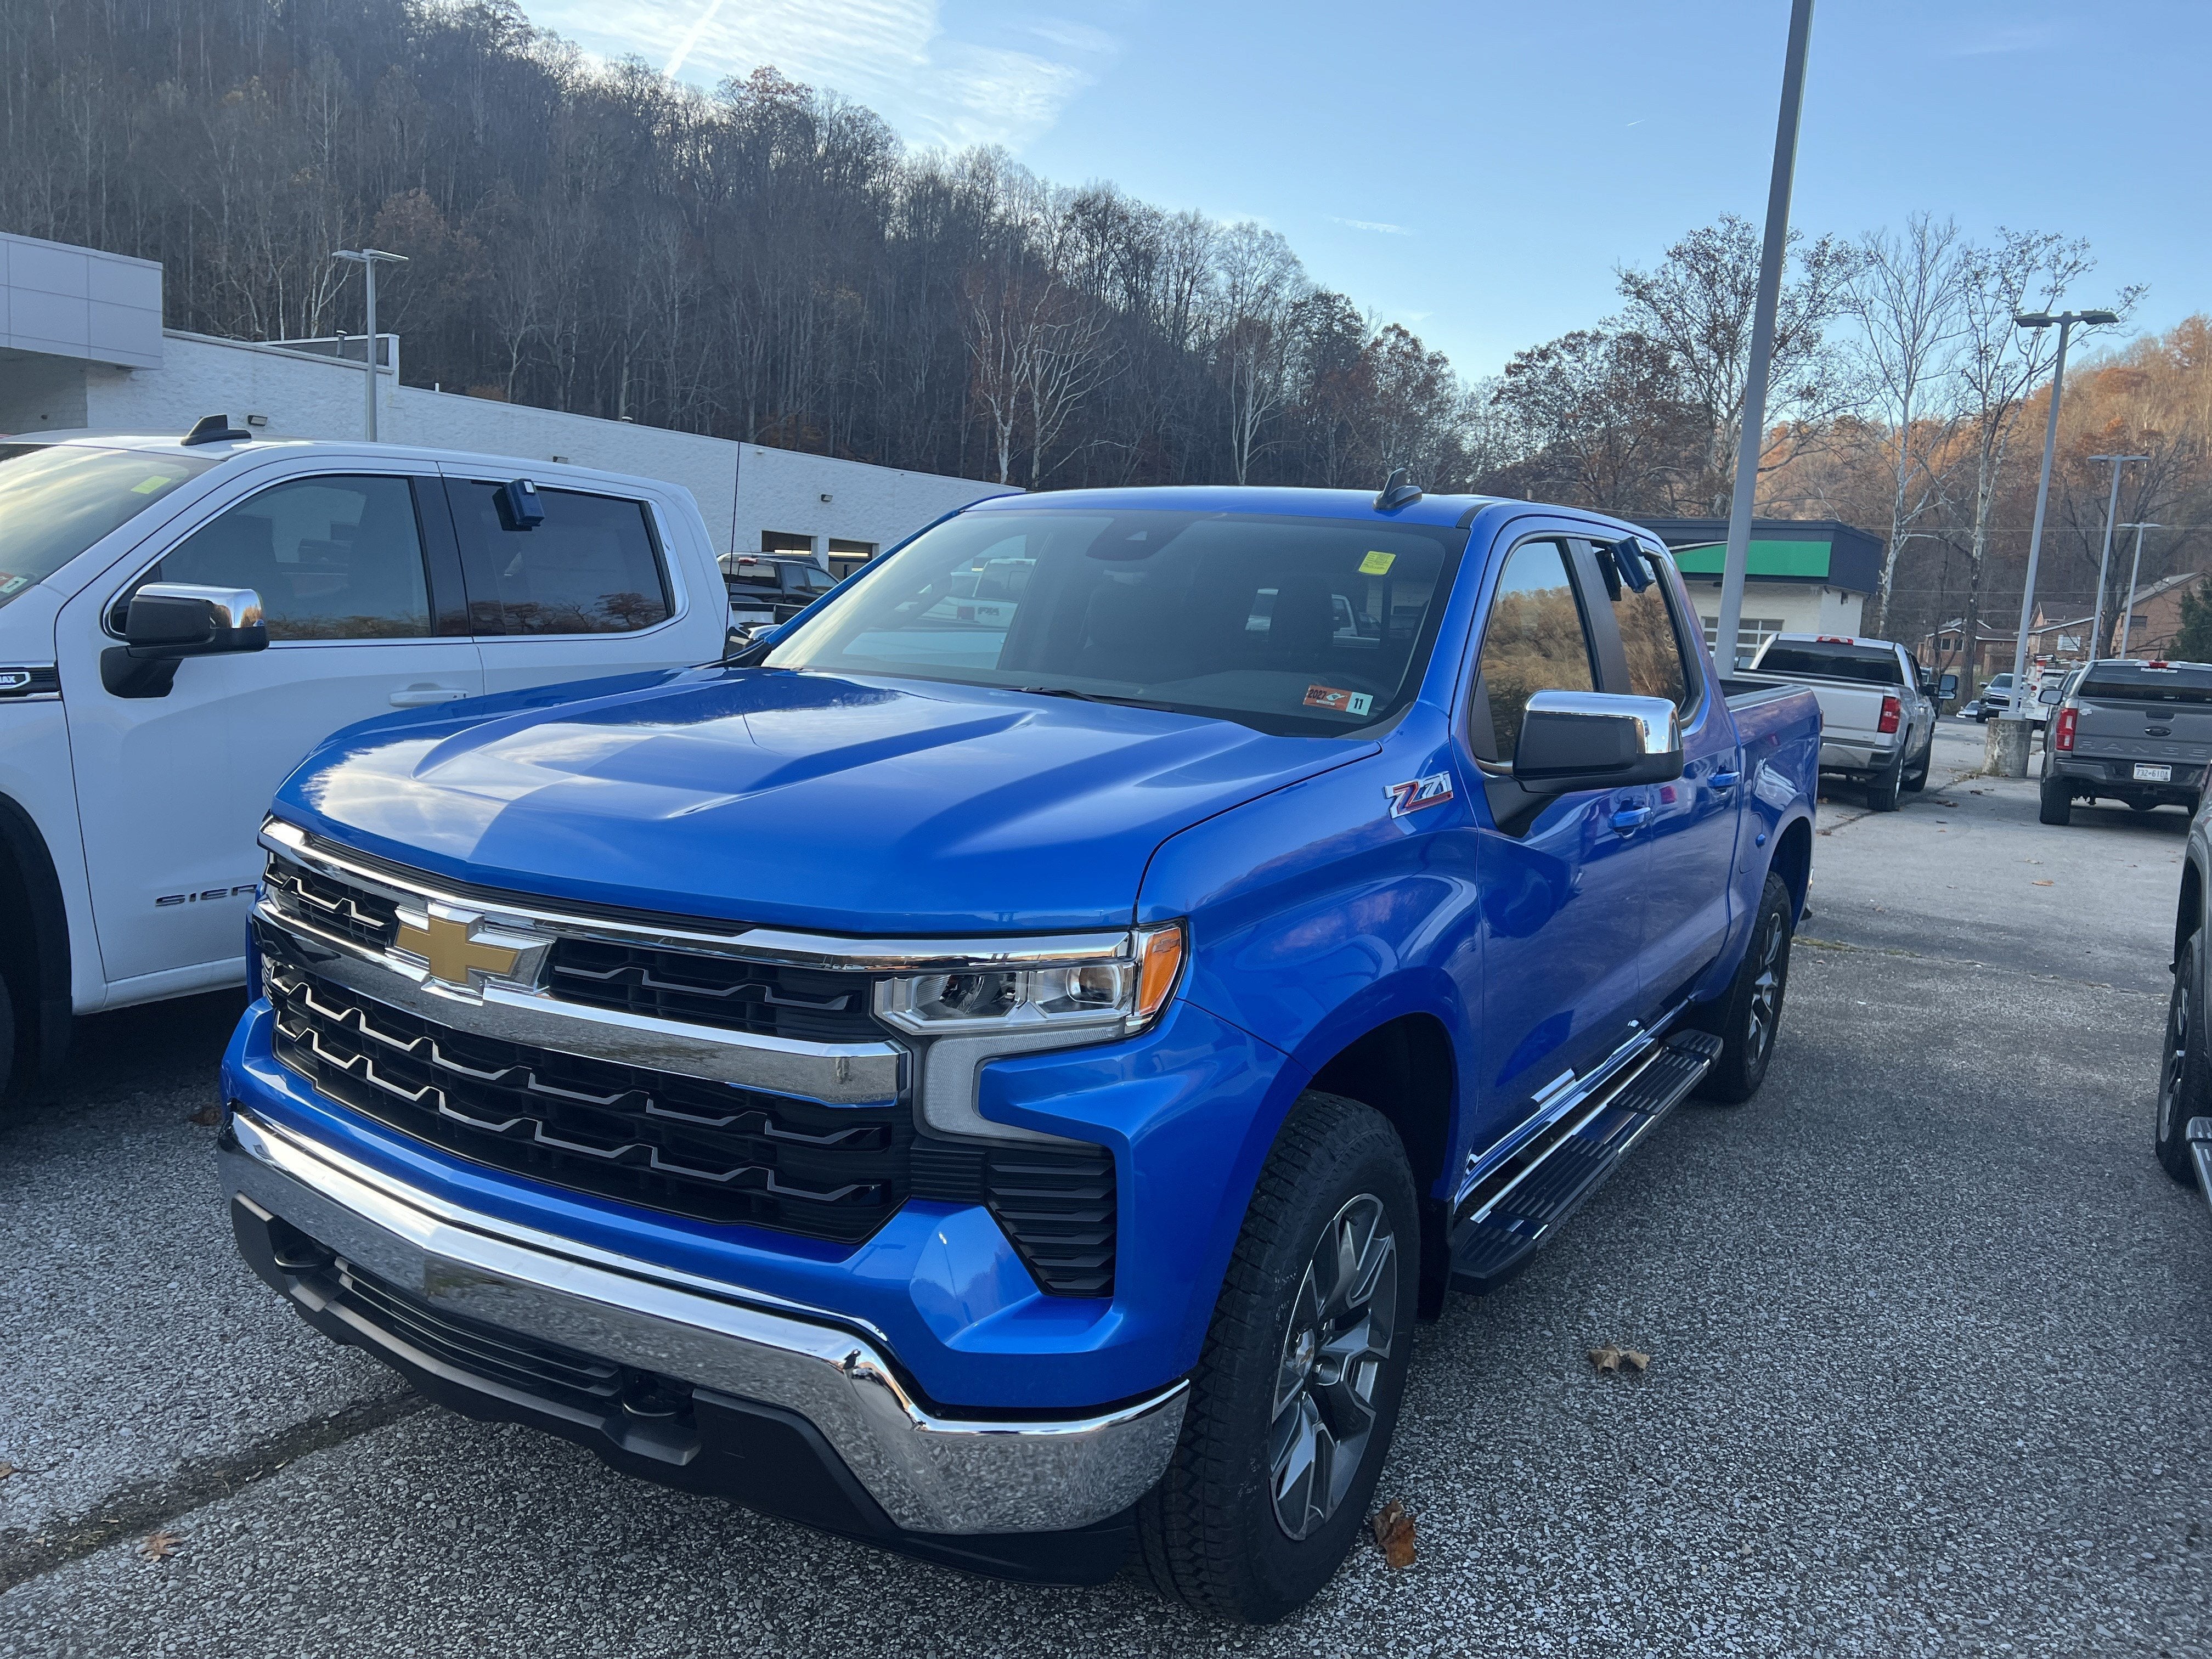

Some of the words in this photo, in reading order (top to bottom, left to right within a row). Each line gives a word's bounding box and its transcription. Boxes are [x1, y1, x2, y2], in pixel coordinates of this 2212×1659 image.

[0, 675, 16, 684] AX
[1307, 689, 1327, 700] 2027
[1353, 698, 1364, 710] 11
[1382, 771, 1454, 820] Z71
